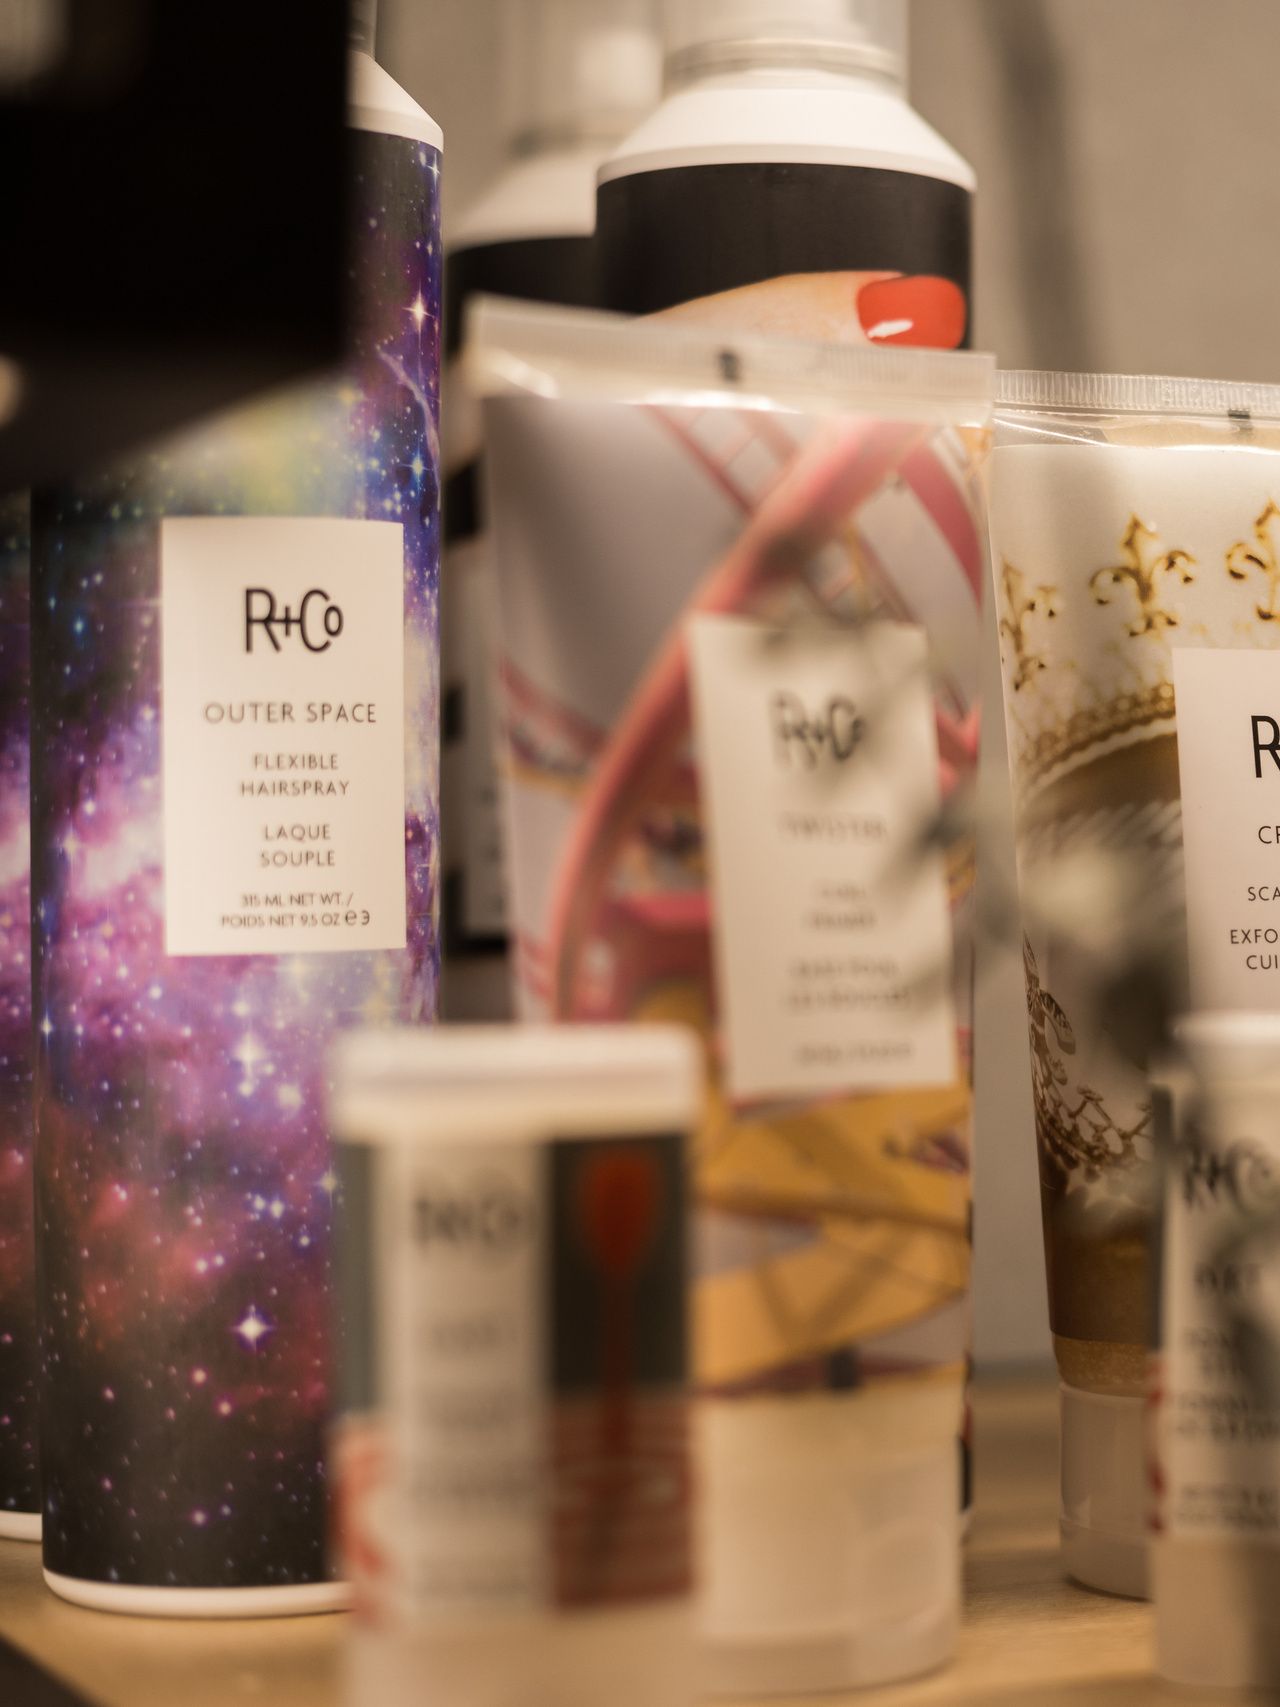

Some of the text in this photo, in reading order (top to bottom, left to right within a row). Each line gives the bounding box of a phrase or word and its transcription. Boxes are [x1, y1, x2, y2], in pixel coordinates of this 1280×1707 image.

[245, 587, 344, 653] R+Co
[204, 702, 377, 724] OUTER SPACE
[253, 753, 339, 771] FLEXIBLE
[240, 780, 350, 797] HAIRSPRAY
[264, 824, 331, 842] LAQUE
[261, 851, 336, 867] SOUPLE
[242, 894, 261, 908] 315
[265, 894, 285, 907] ML
[290, 893, 316, 907] NET
[222, 913, 265, 928] POIDS
[270, 914, 296, 927] NET
[300, 913, 318, 927] 9.5
[322, 913, 340, 926] OZ
